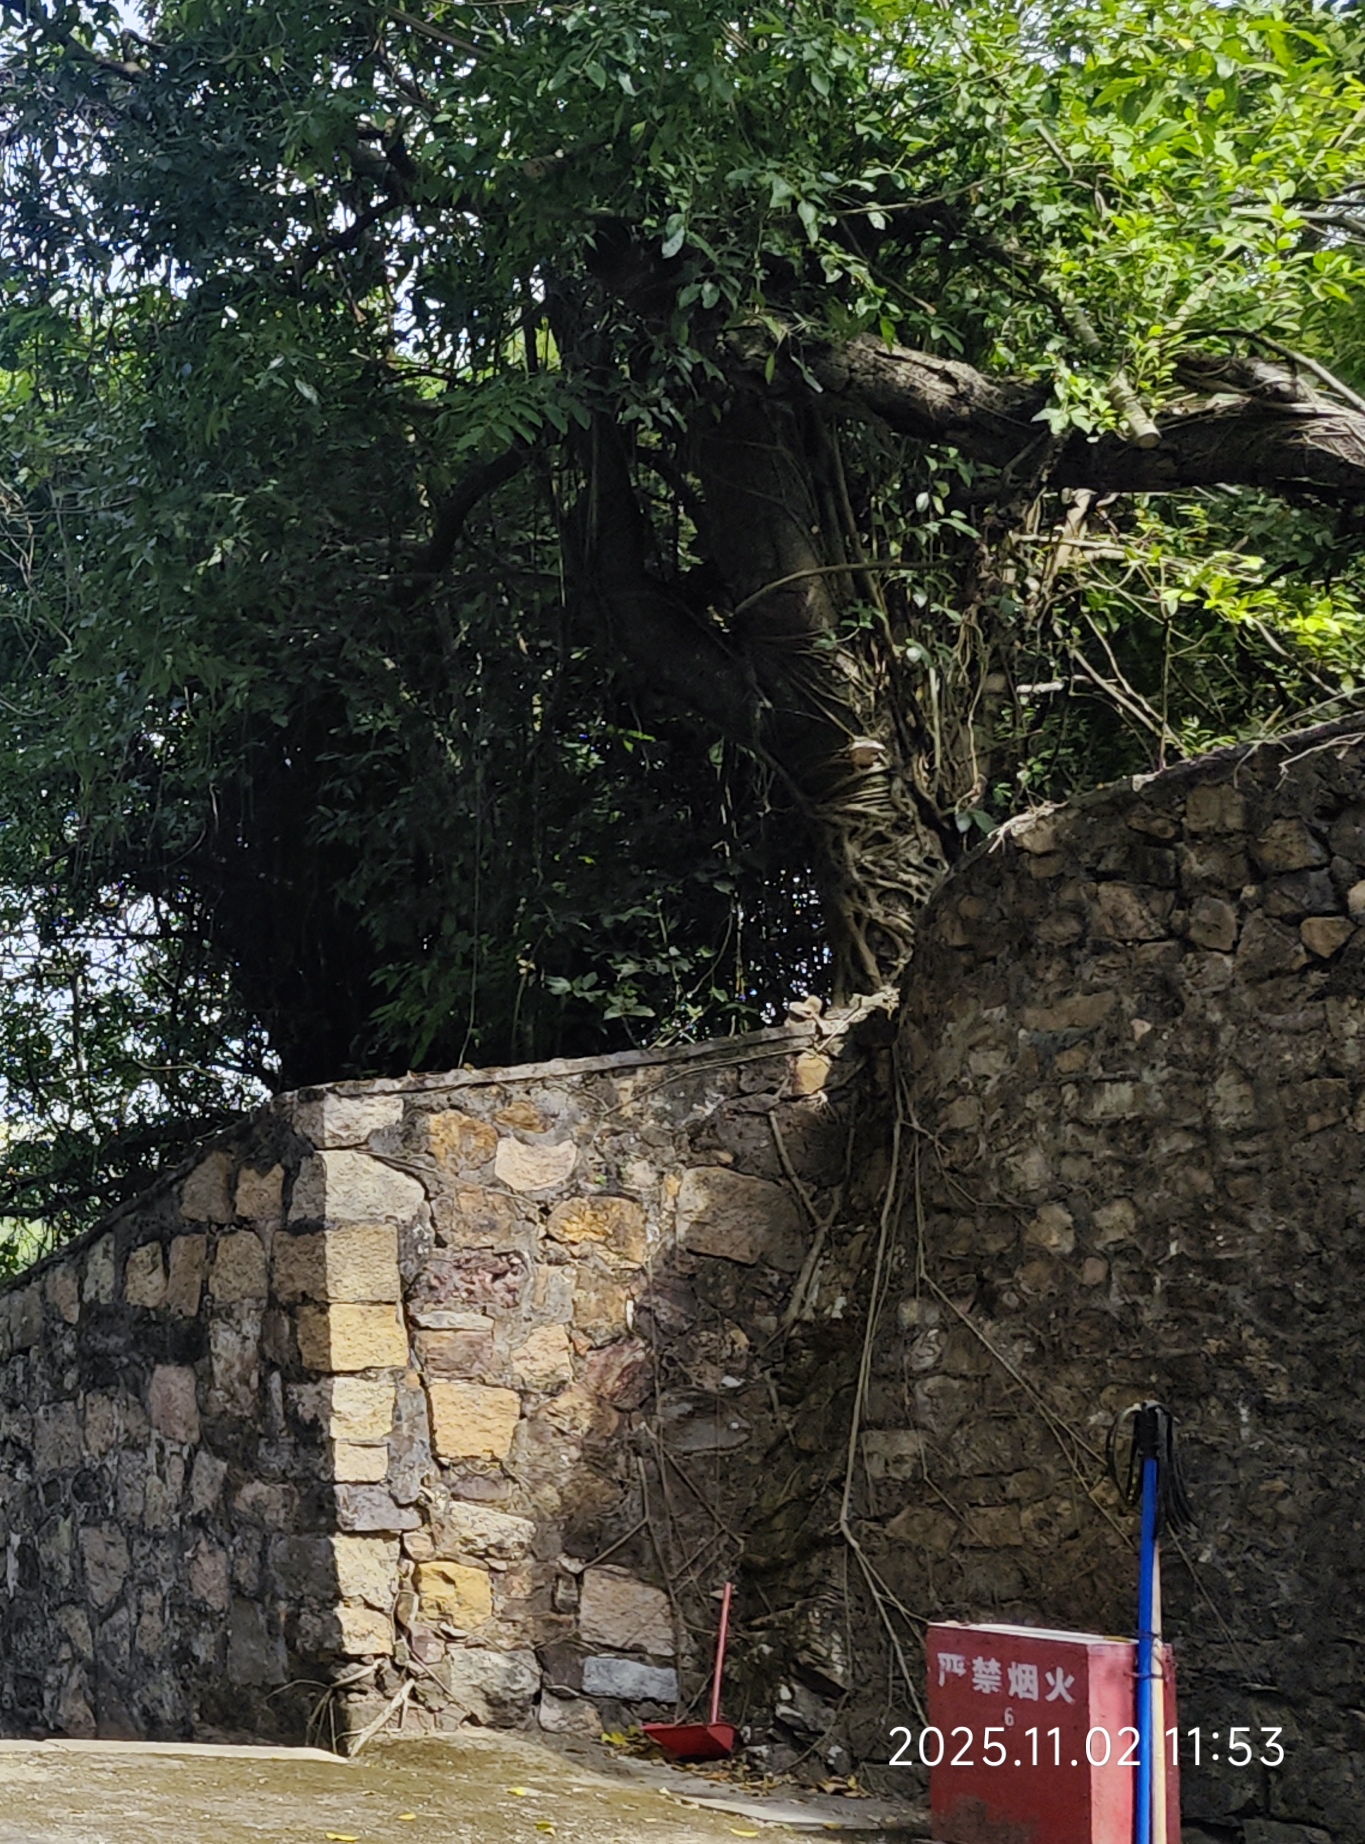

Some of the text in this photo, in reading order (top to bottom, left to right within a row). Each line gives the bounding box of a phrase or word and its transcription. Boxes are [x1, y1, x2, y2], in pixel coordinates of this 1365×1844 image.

[936, 1651, 1076, 1705] 严禁烟火
[1004, 1706, 1016, 1728] 6
